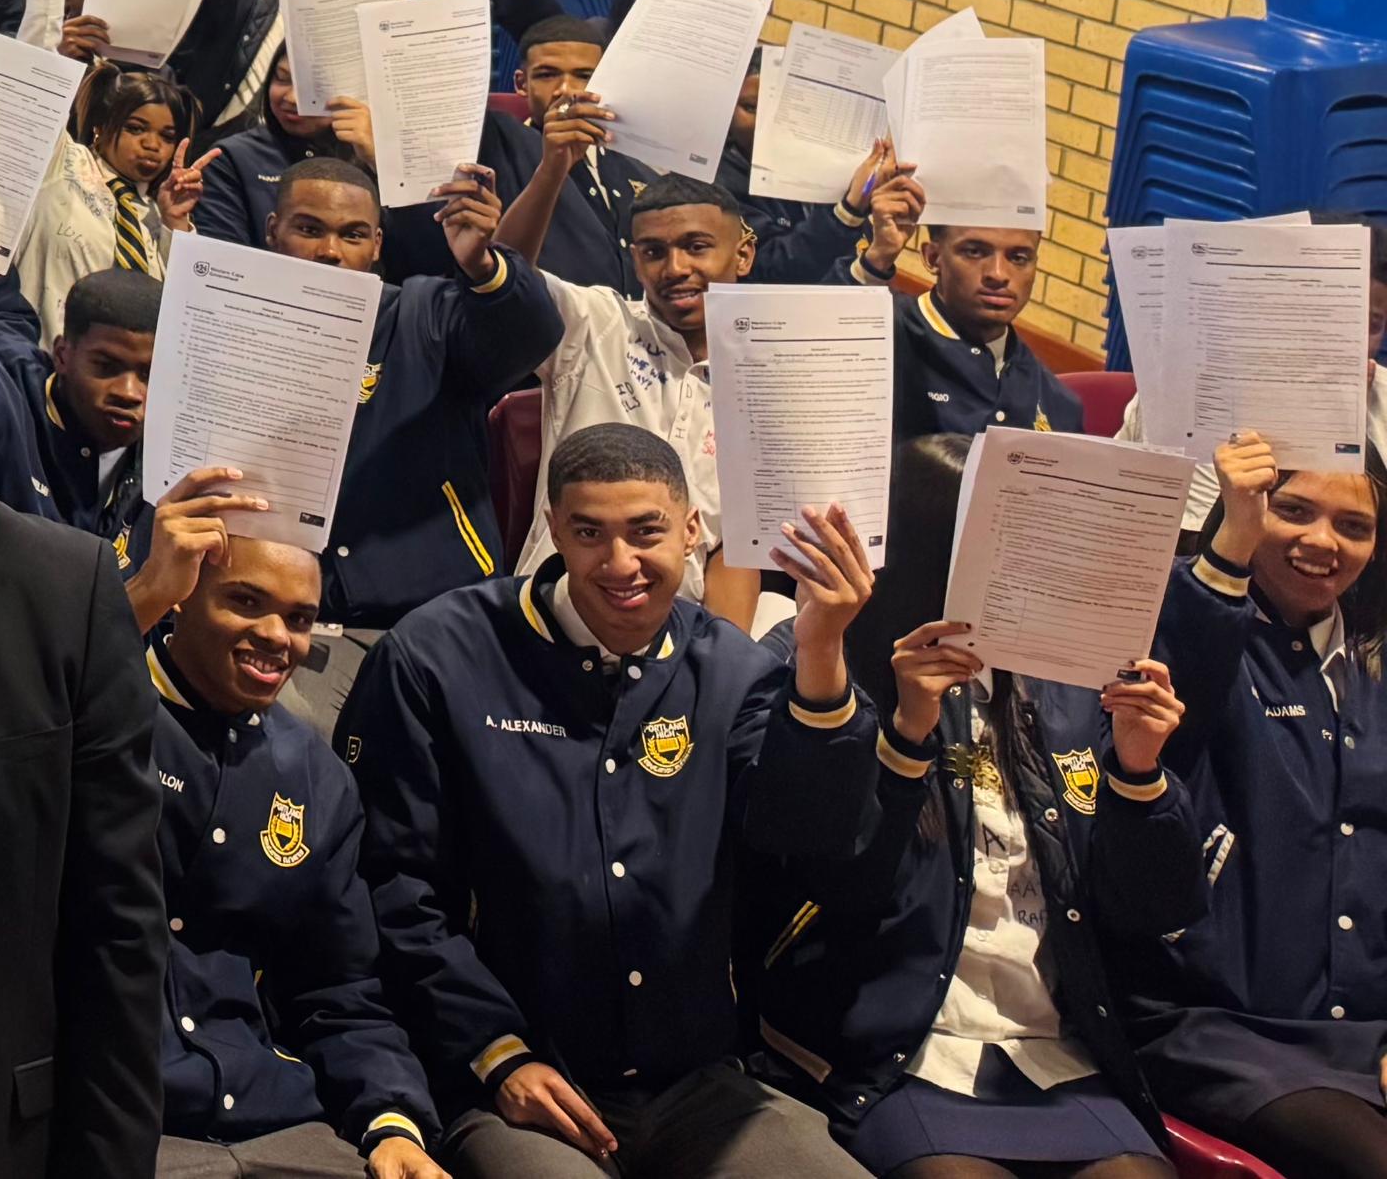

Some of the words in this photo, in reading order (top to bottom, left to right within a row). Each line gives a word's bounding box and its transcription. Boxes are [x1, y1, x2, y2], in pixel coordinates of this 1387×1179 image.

[1265, 704, 1306, 717] ADAMS
[501, 718, 566, 737] ALEXANDER
[643, 722, 686, 733] PORTLAND
[982, 823, 1007, 857] A
